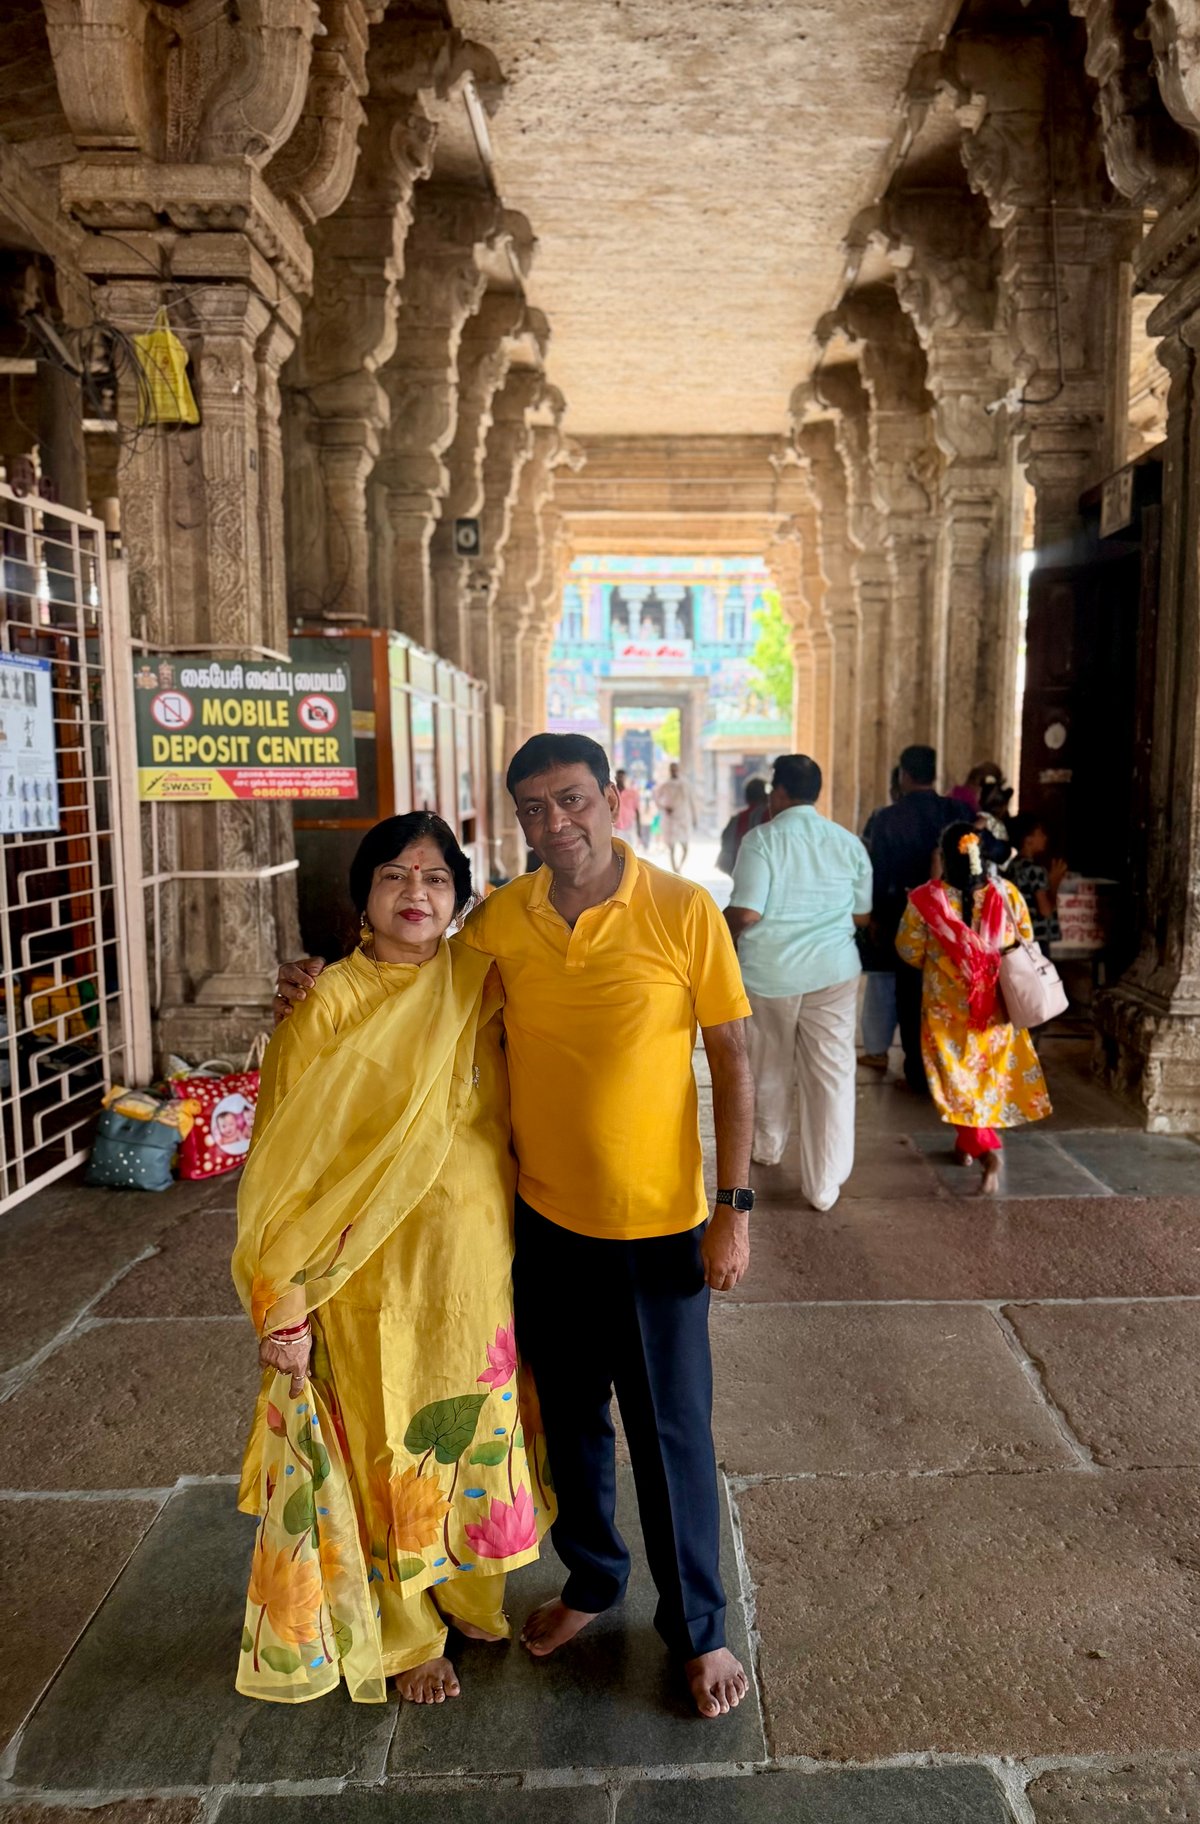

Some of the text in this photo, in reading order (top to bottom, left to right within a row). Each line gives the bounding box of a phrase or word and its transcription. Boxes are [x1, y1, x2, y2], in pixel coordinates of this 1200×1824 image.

[180, 662, 347, 697] கைபேசி வைப்பு மையம்
[202, 698, 290, 728] MOBILE
[152, 735, 340, 764] DEPOSIT CENTER
[161, 782, 212, 791] SWASTI
